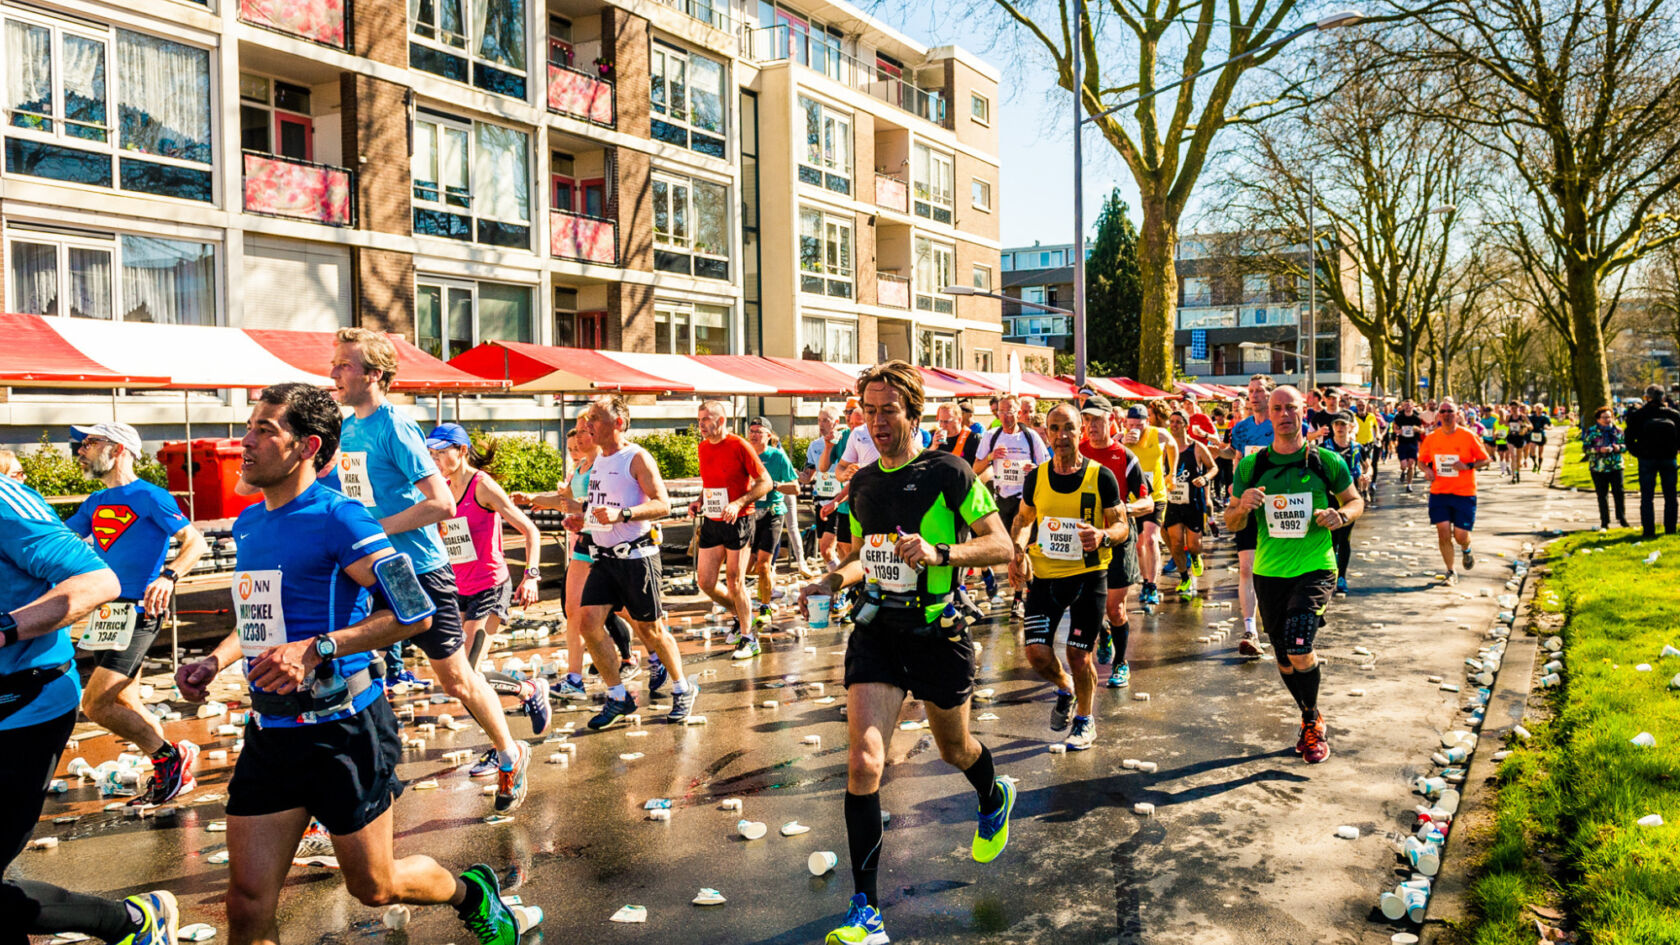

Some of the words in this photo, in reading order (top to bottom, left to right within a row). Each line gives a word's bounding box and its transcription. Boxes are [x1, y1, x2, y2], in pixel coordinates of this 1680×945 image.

[351, 458, 360, 466] NN
[344, 473, 360, 484] MARK
[1274, 510, 1305, 520] GERARD
[1280, 520, 1301, 530] 4992
[1050, 532, 1073, 542] YUSUF
[1050, 542, 1070, 552] 3228
[866, 550, 904, 564] GERT-JA
[874, 564, 900, 580] 11399
[254, 580, 270, 592] NN
[242, 622, 266, 642] 12330
